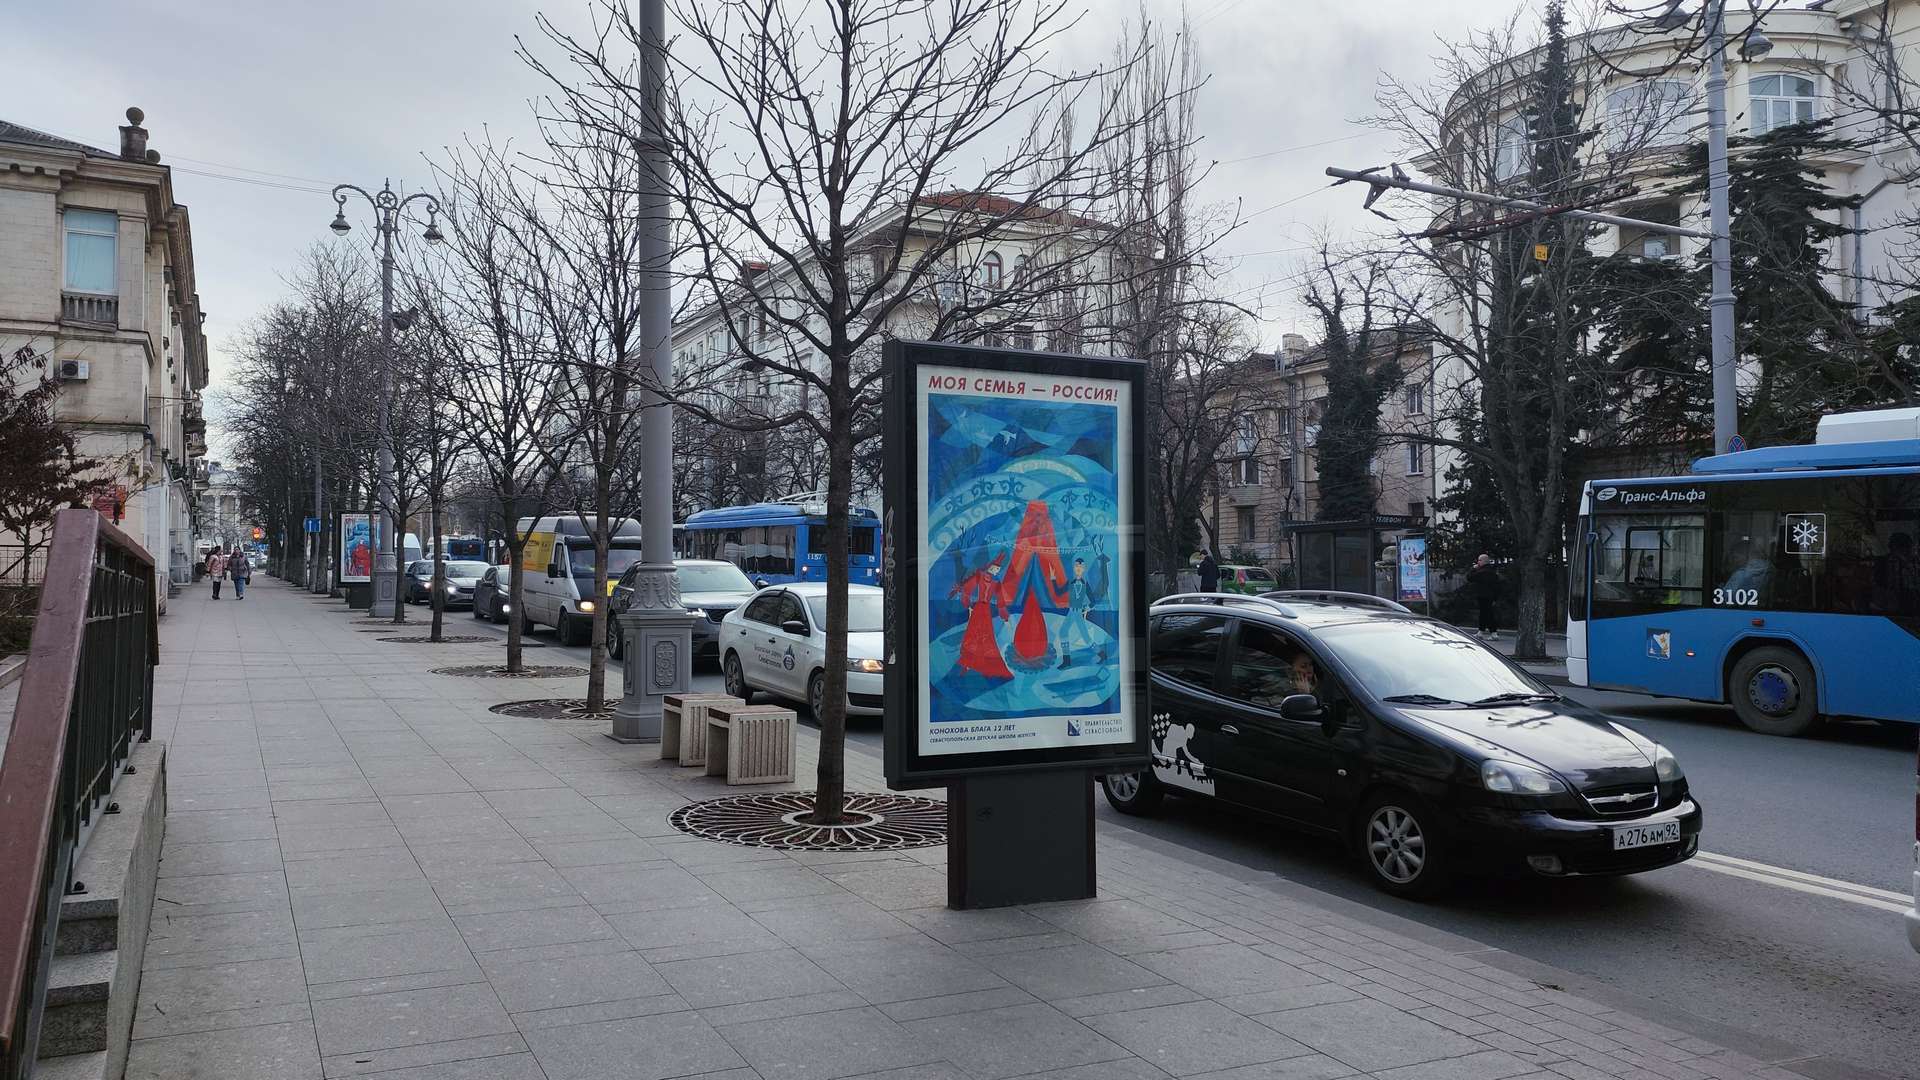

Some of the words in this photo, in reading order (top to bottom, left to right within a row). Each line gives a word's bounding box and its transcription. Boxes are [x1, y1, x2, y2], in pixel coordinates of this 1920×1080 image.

[928, 375, 967, 391] МОЯ
[974, 378, 1026, 395] СЕМЬЯ
[1052, 384, 1119, 402] РОССИЯ!
[1619, 488, 1706, 504] Транс-Альфа
[1713, 588, 1759, 606] 3102
[929, 726, 969, 735] КОНОХОВА
[971, 725, 991, 733] БЛАГА
[1665, 823, 1677, 837] 92
